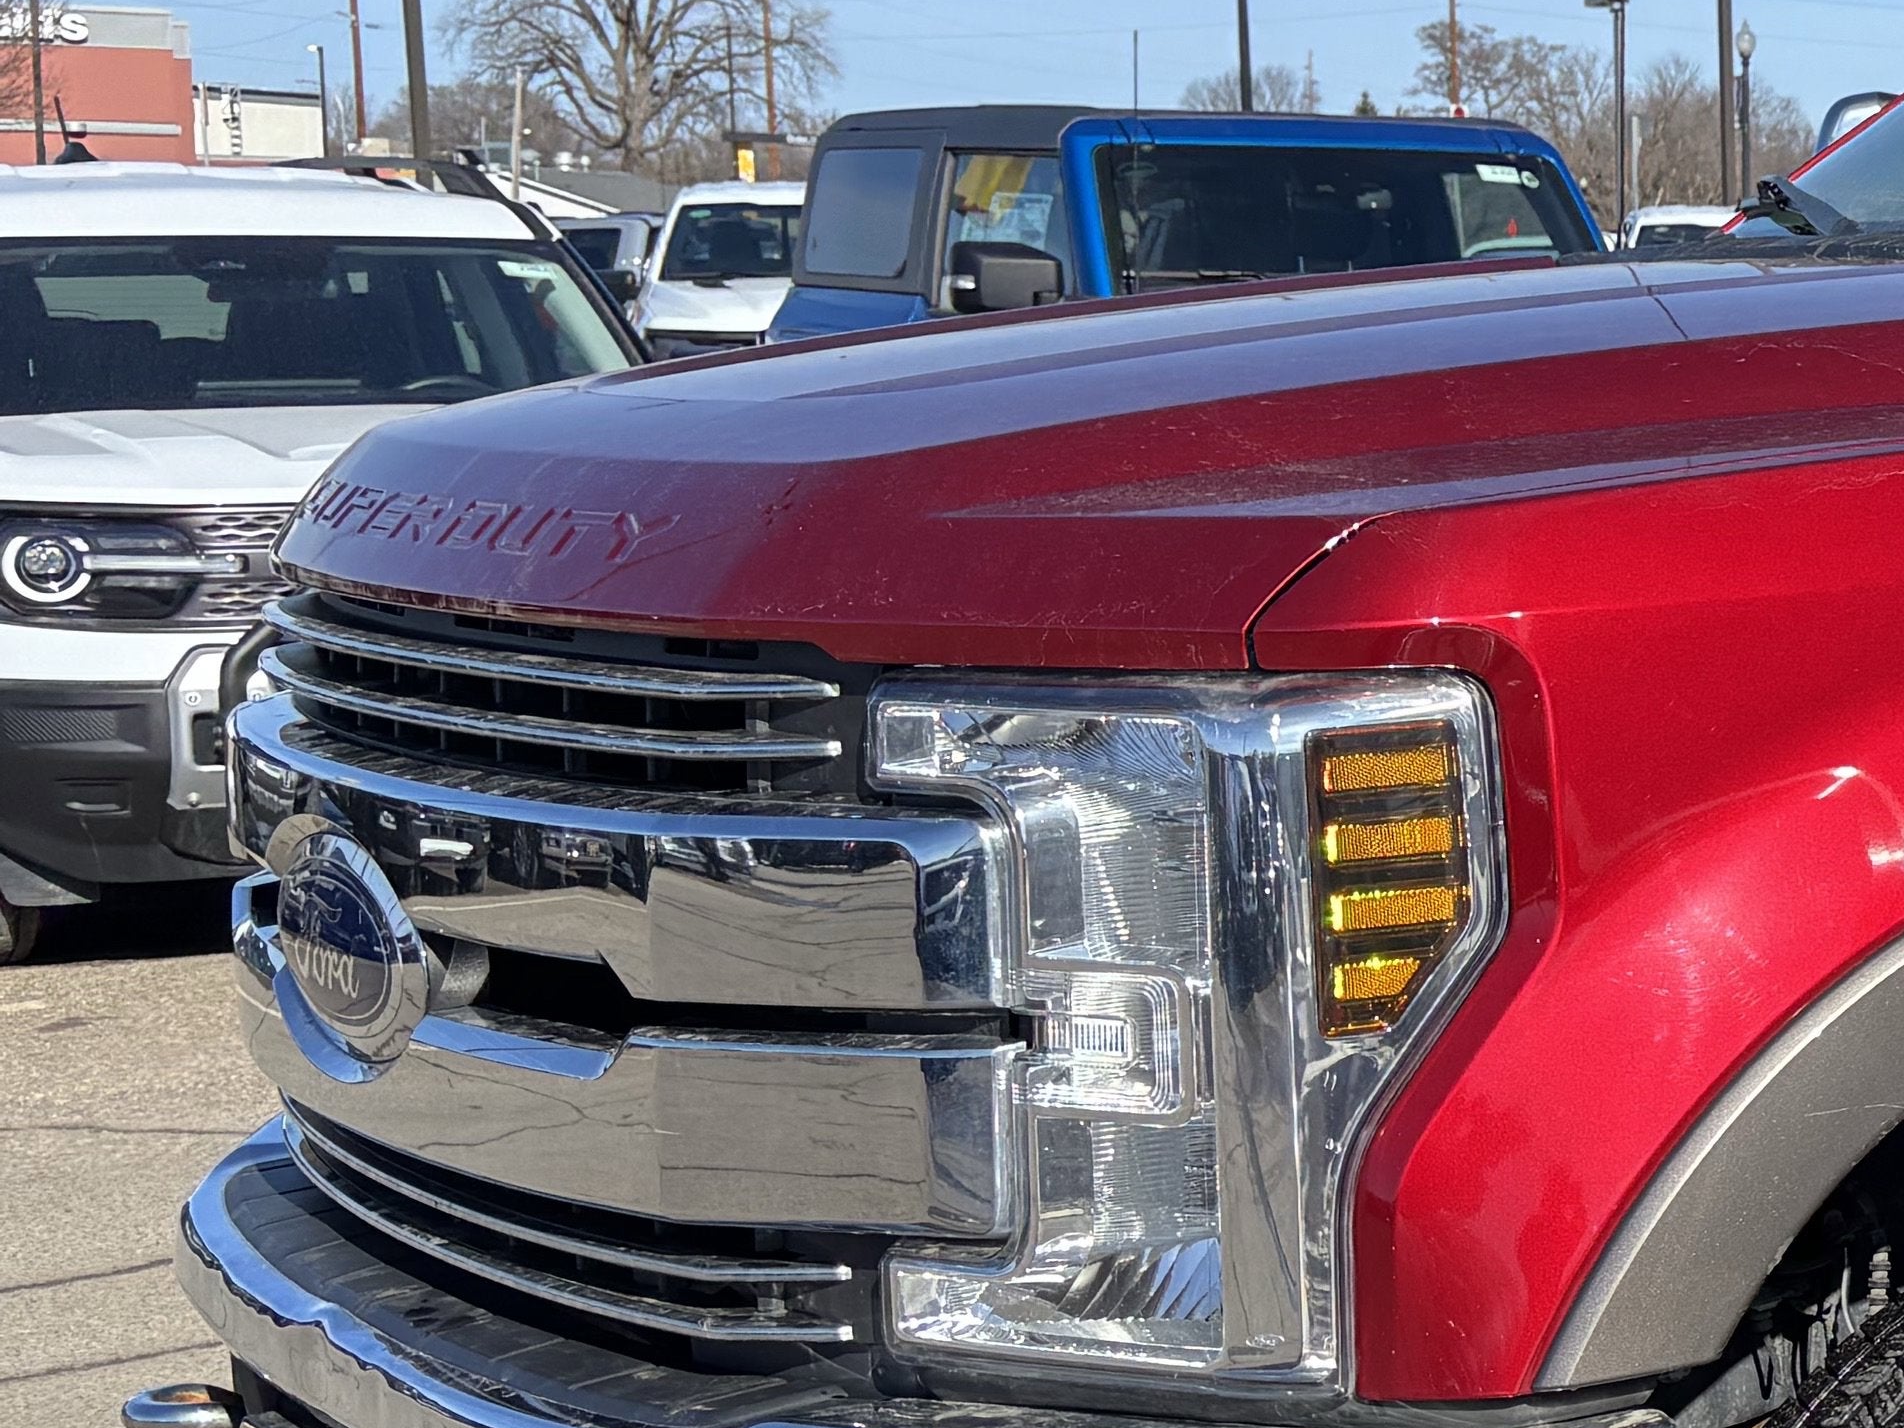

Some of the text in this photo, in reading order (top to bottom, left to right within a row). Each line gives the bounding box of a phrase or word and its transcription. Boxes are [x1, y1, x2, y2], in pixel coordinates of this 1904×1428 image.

[302, 479, 682, 562] SUPER DUTY
[293, 892, 360, 999] Ford
